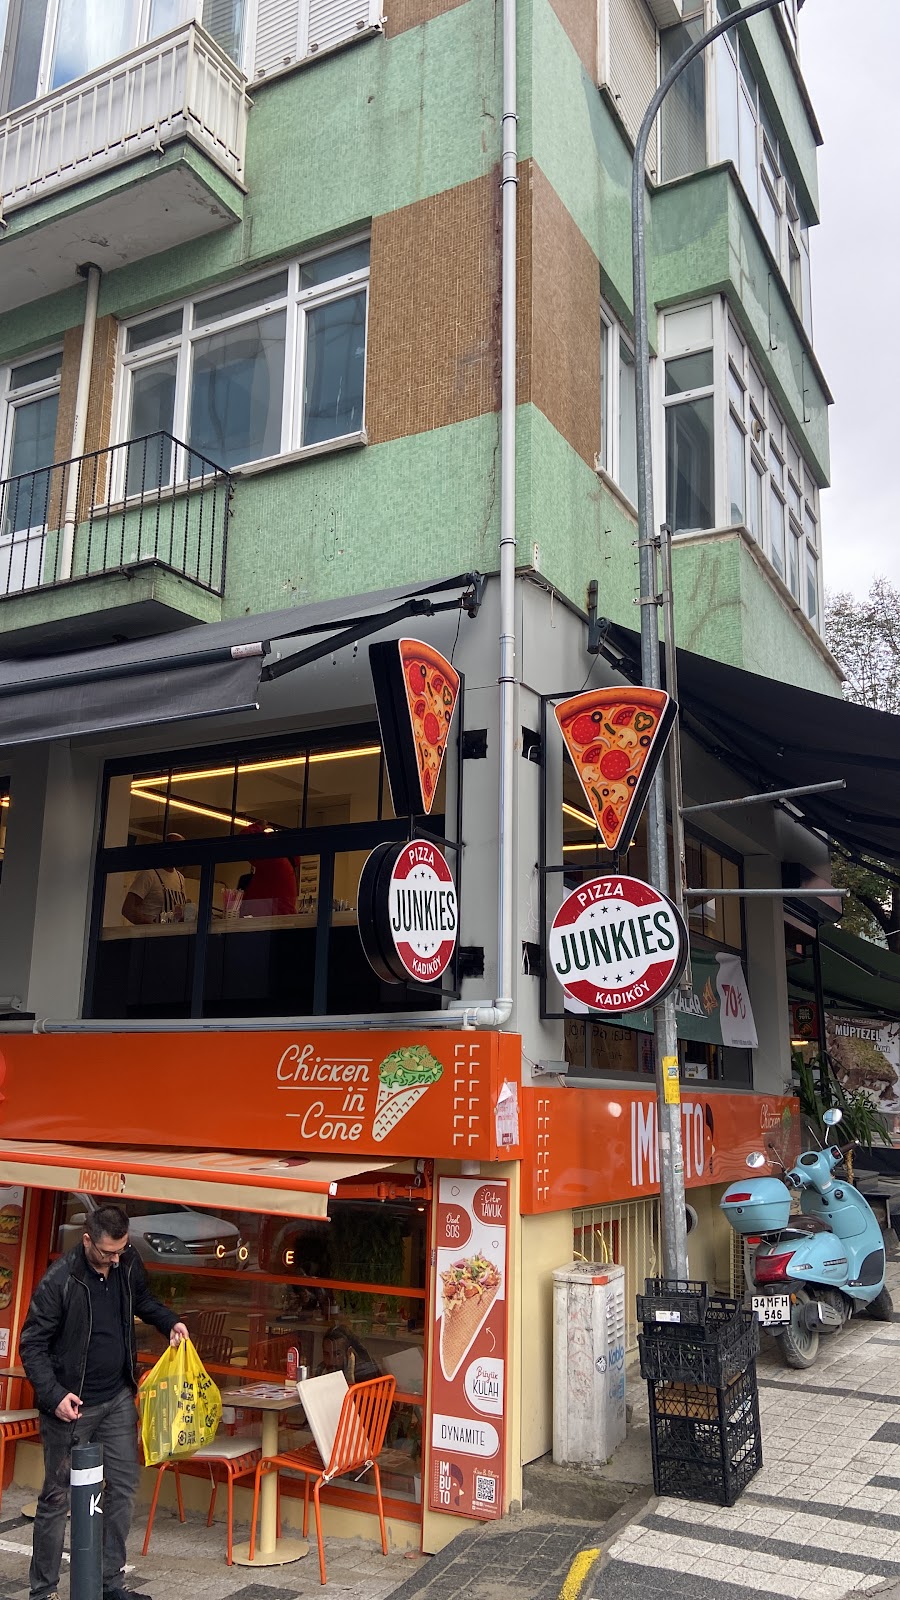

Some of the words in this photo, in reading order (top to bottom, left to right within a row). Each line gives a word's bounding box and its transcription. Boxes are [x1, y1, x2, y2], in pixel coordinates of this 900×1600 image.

[408, 847, 434, 866] PIZZA
[577, 883, 624, 906] PIZZA
[393, 889, 455, 931] JUNKIES
[555, 910, 675, 975] JUNKIES
[412, 956, 441, 975] KADIKÖY
[595, 980, 650, 1005] KADIKÖY
[276, 1044, 370, 1082] Chicken
[342, 1086, 365, 1112] in
[301, 1101, 363, 1141] Cone
[631, 1101, 704, 1187] IMTO
[78, 1171, 120, 1193] IMBUTO
[481, 1203, 502, 1218] TAVUK
[445, 1224, 460, 1238] SOS
[754, 1298, 764, 1308] 34
[767, 1296, 788, 1307] MFH
[764, 1309, 782, 1320] 546
[472, 1379, 499, 1397] KÜLAH
[441, 1424, 486, 1446] DYNAMITE
[439, 1460, 449, 1476] IM
[439, 1475, 451, 1490] BU
[89, 1492, 103, 1516] K
[439, 1489, 450, 1504] TO
